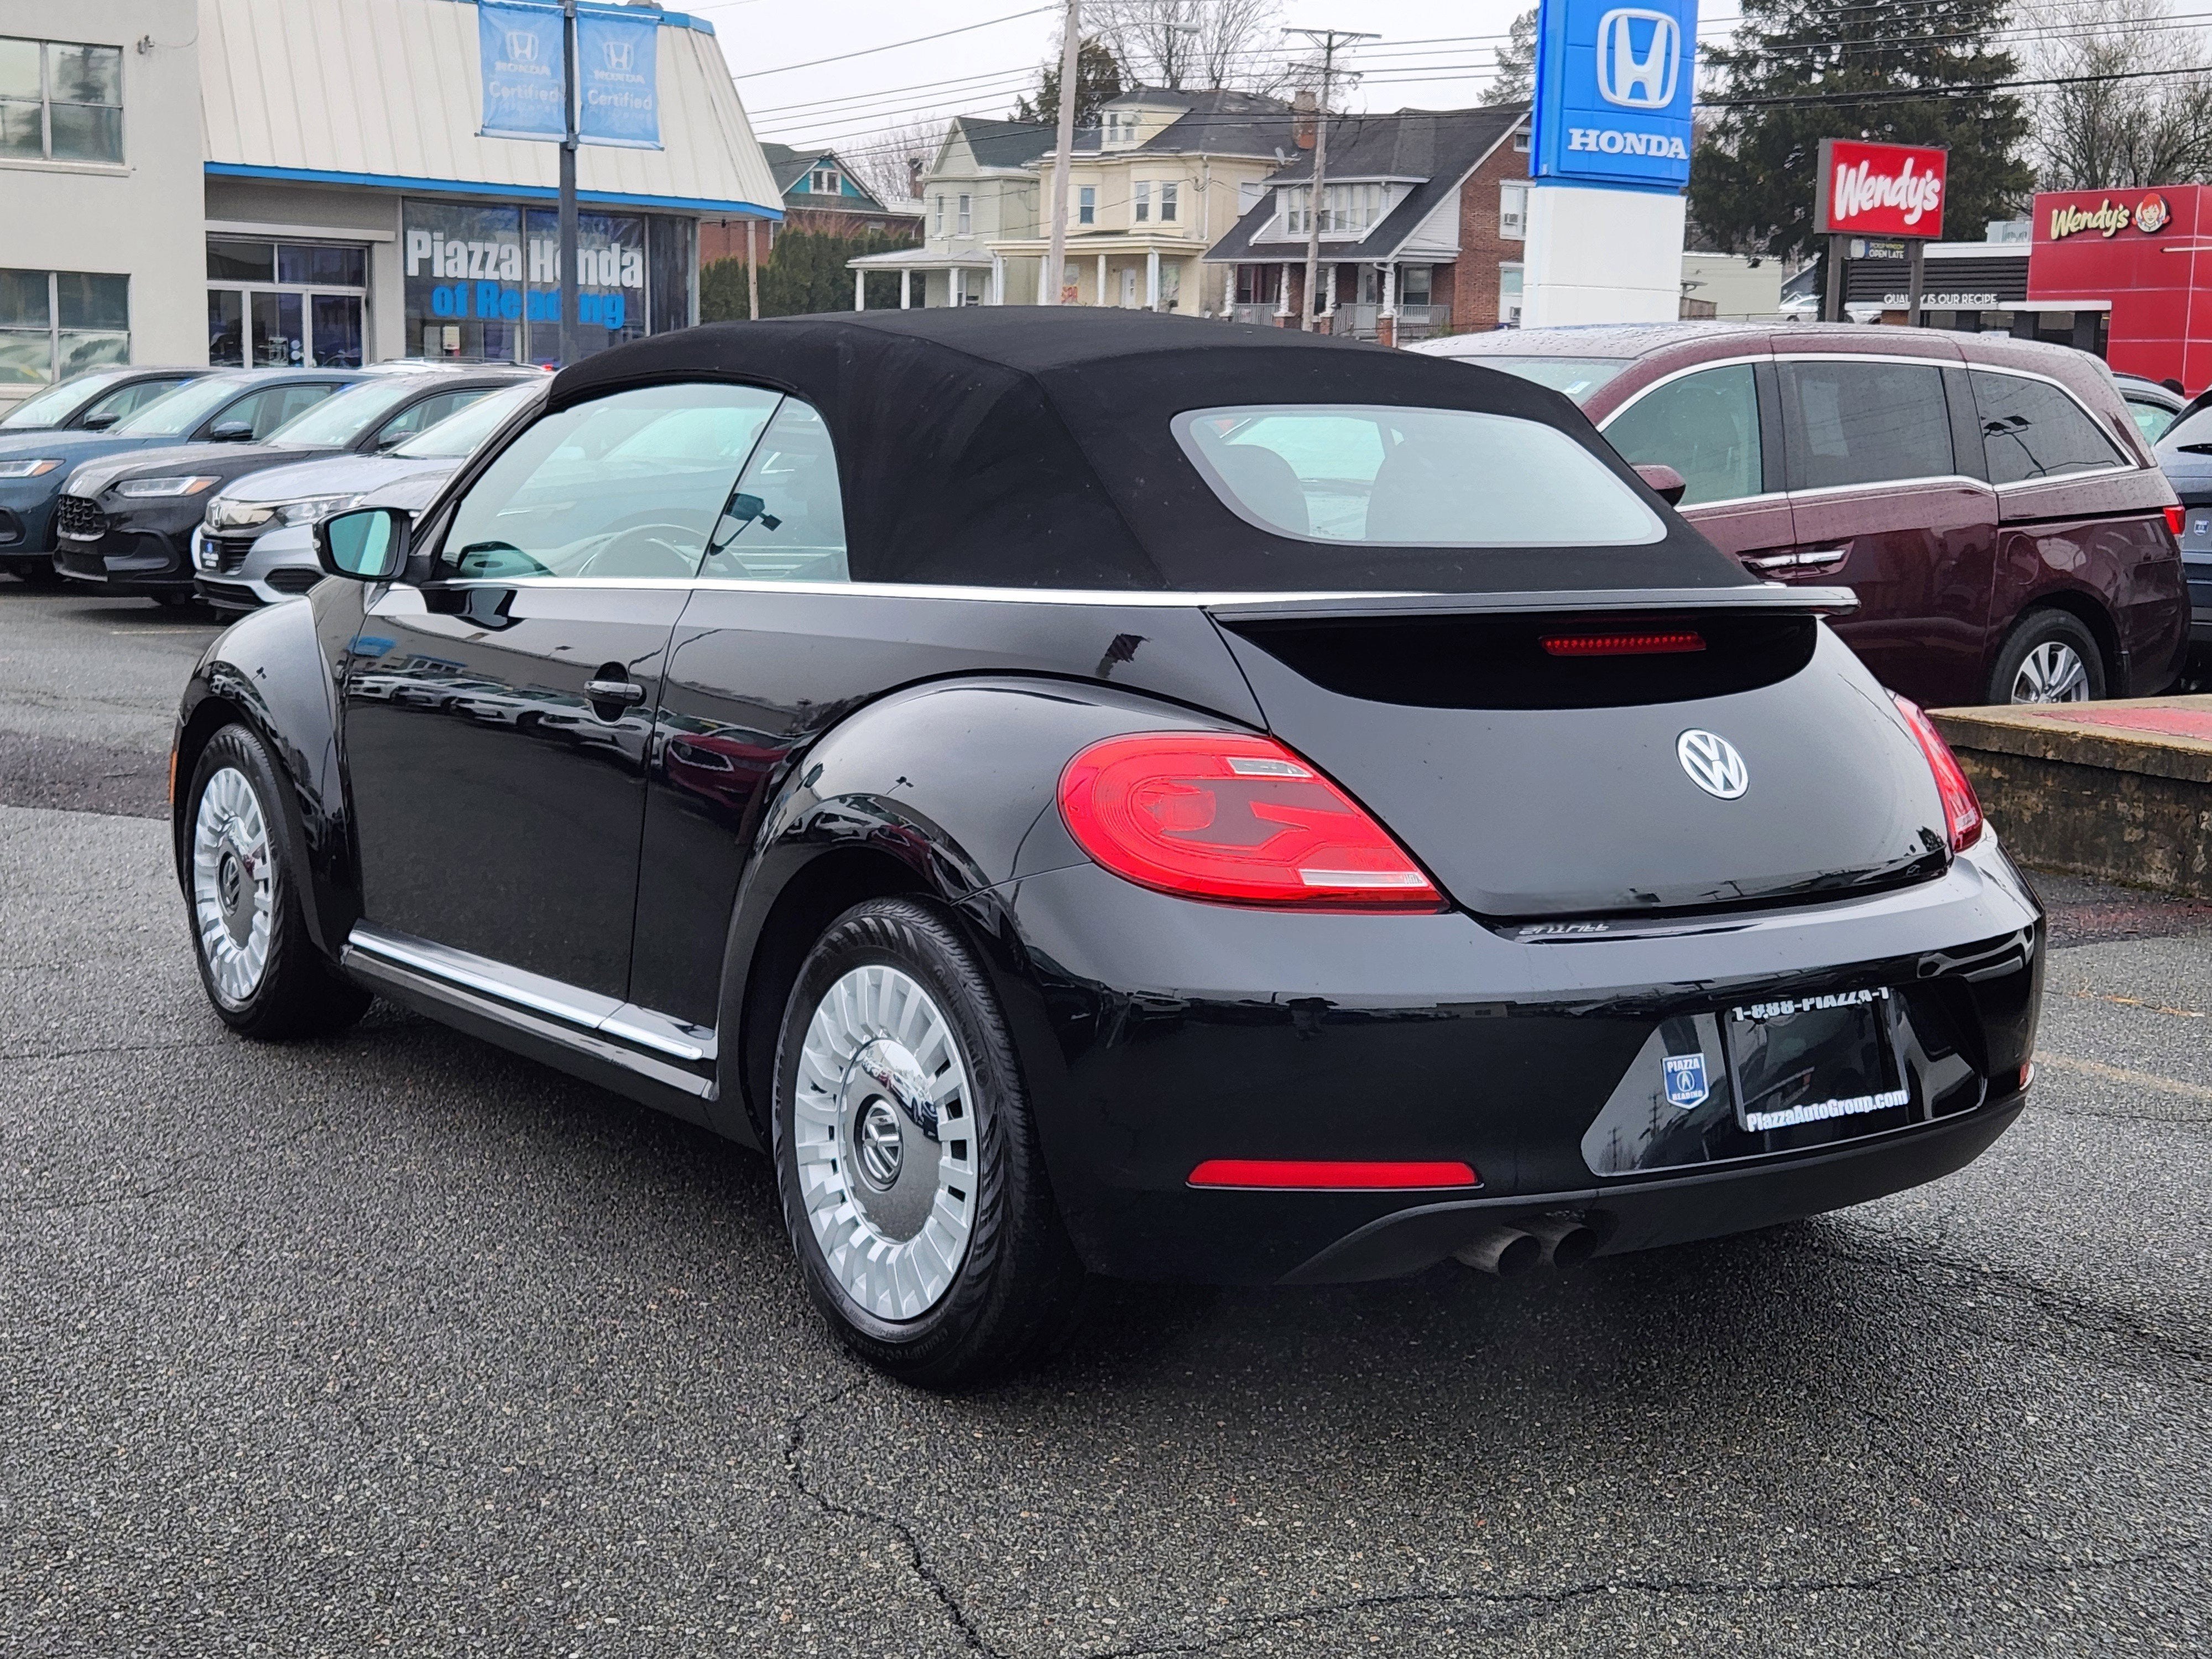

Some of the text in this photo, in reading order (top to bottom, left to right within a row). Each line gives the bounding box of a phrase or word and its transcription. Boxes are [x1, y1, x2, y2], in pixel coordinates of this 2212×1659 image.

[488, 80, 561, 102] Certified
[587, 88, 653, 110] Certified
[1568, 128, 1689, 160] HONDA
[1835, 156, 1940, 225] Wendy's
[2051, 198, 2130, 240] Wendy's
[407, 229, 522, 281] Piazza
[1869, 249, 1905, 259] OPEN LATE
[432, 280, 625, 330] of Readng
[1884, 294, 1998, 305] QUALY IS OUR RECIPE
[1667, 1057, 1700, 1073] PIAZZA
[1746, 1089, 1908, 1132] PiazzaAutoGroup.com
